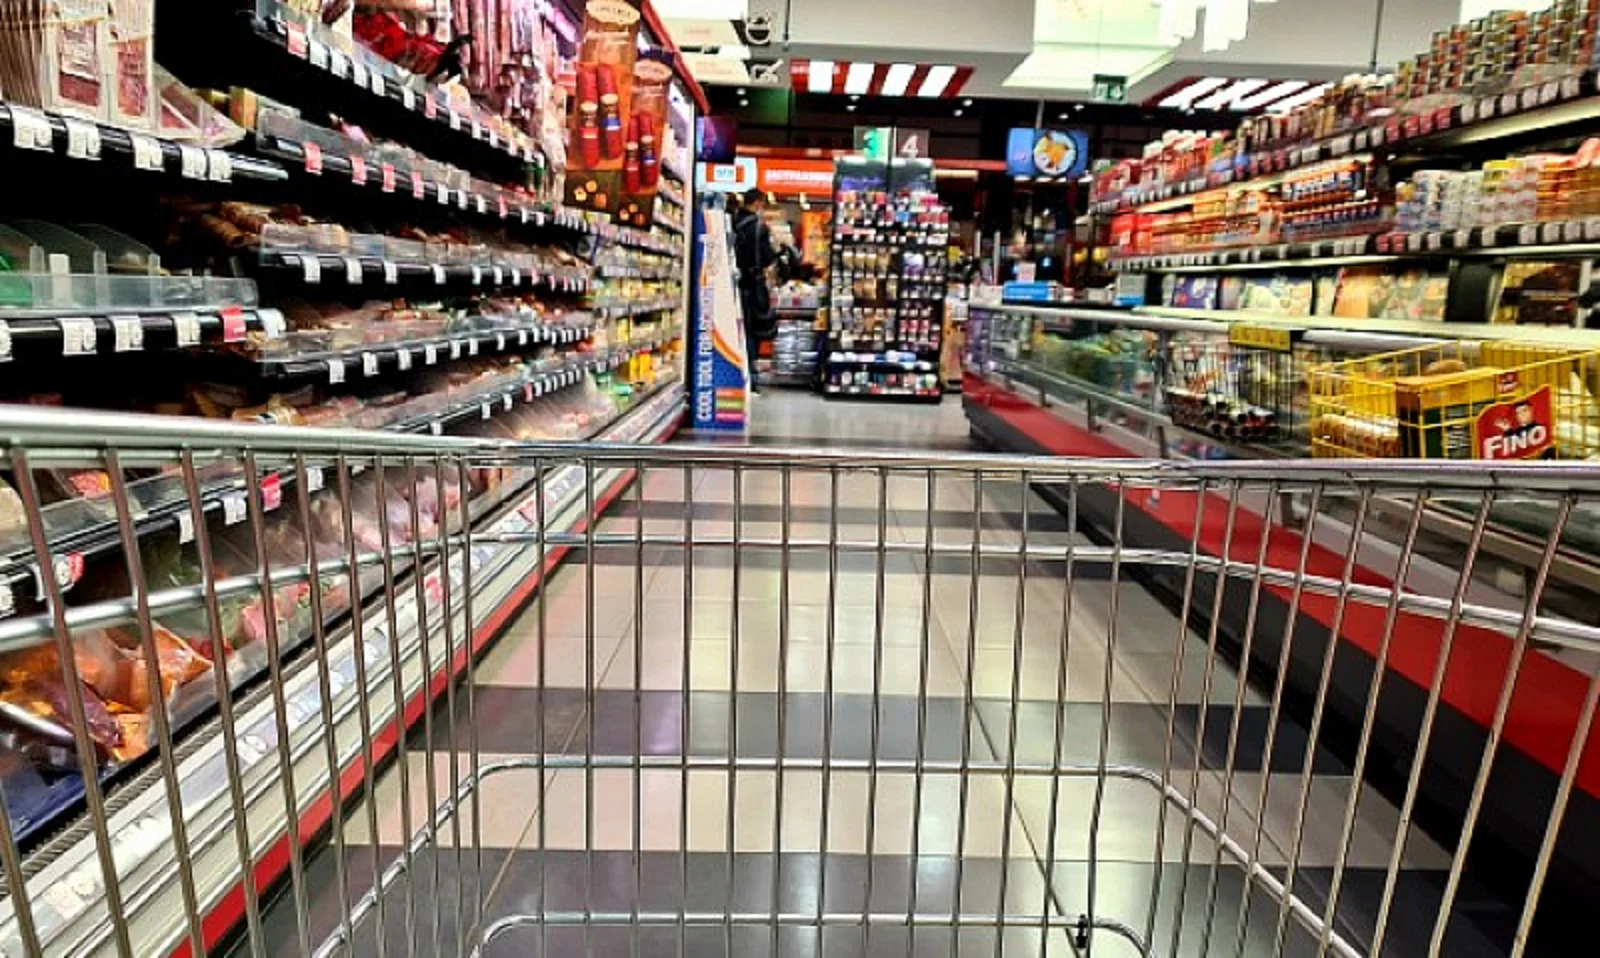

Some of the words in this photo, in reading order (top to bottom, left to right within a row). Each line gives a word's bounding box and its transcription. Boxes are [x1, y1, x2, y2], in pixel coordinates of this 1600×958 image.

[902, 134, 919, 159] 4
[696, 391, 713, 422] COOL
[1483, 425, 1548, 460] FINO
